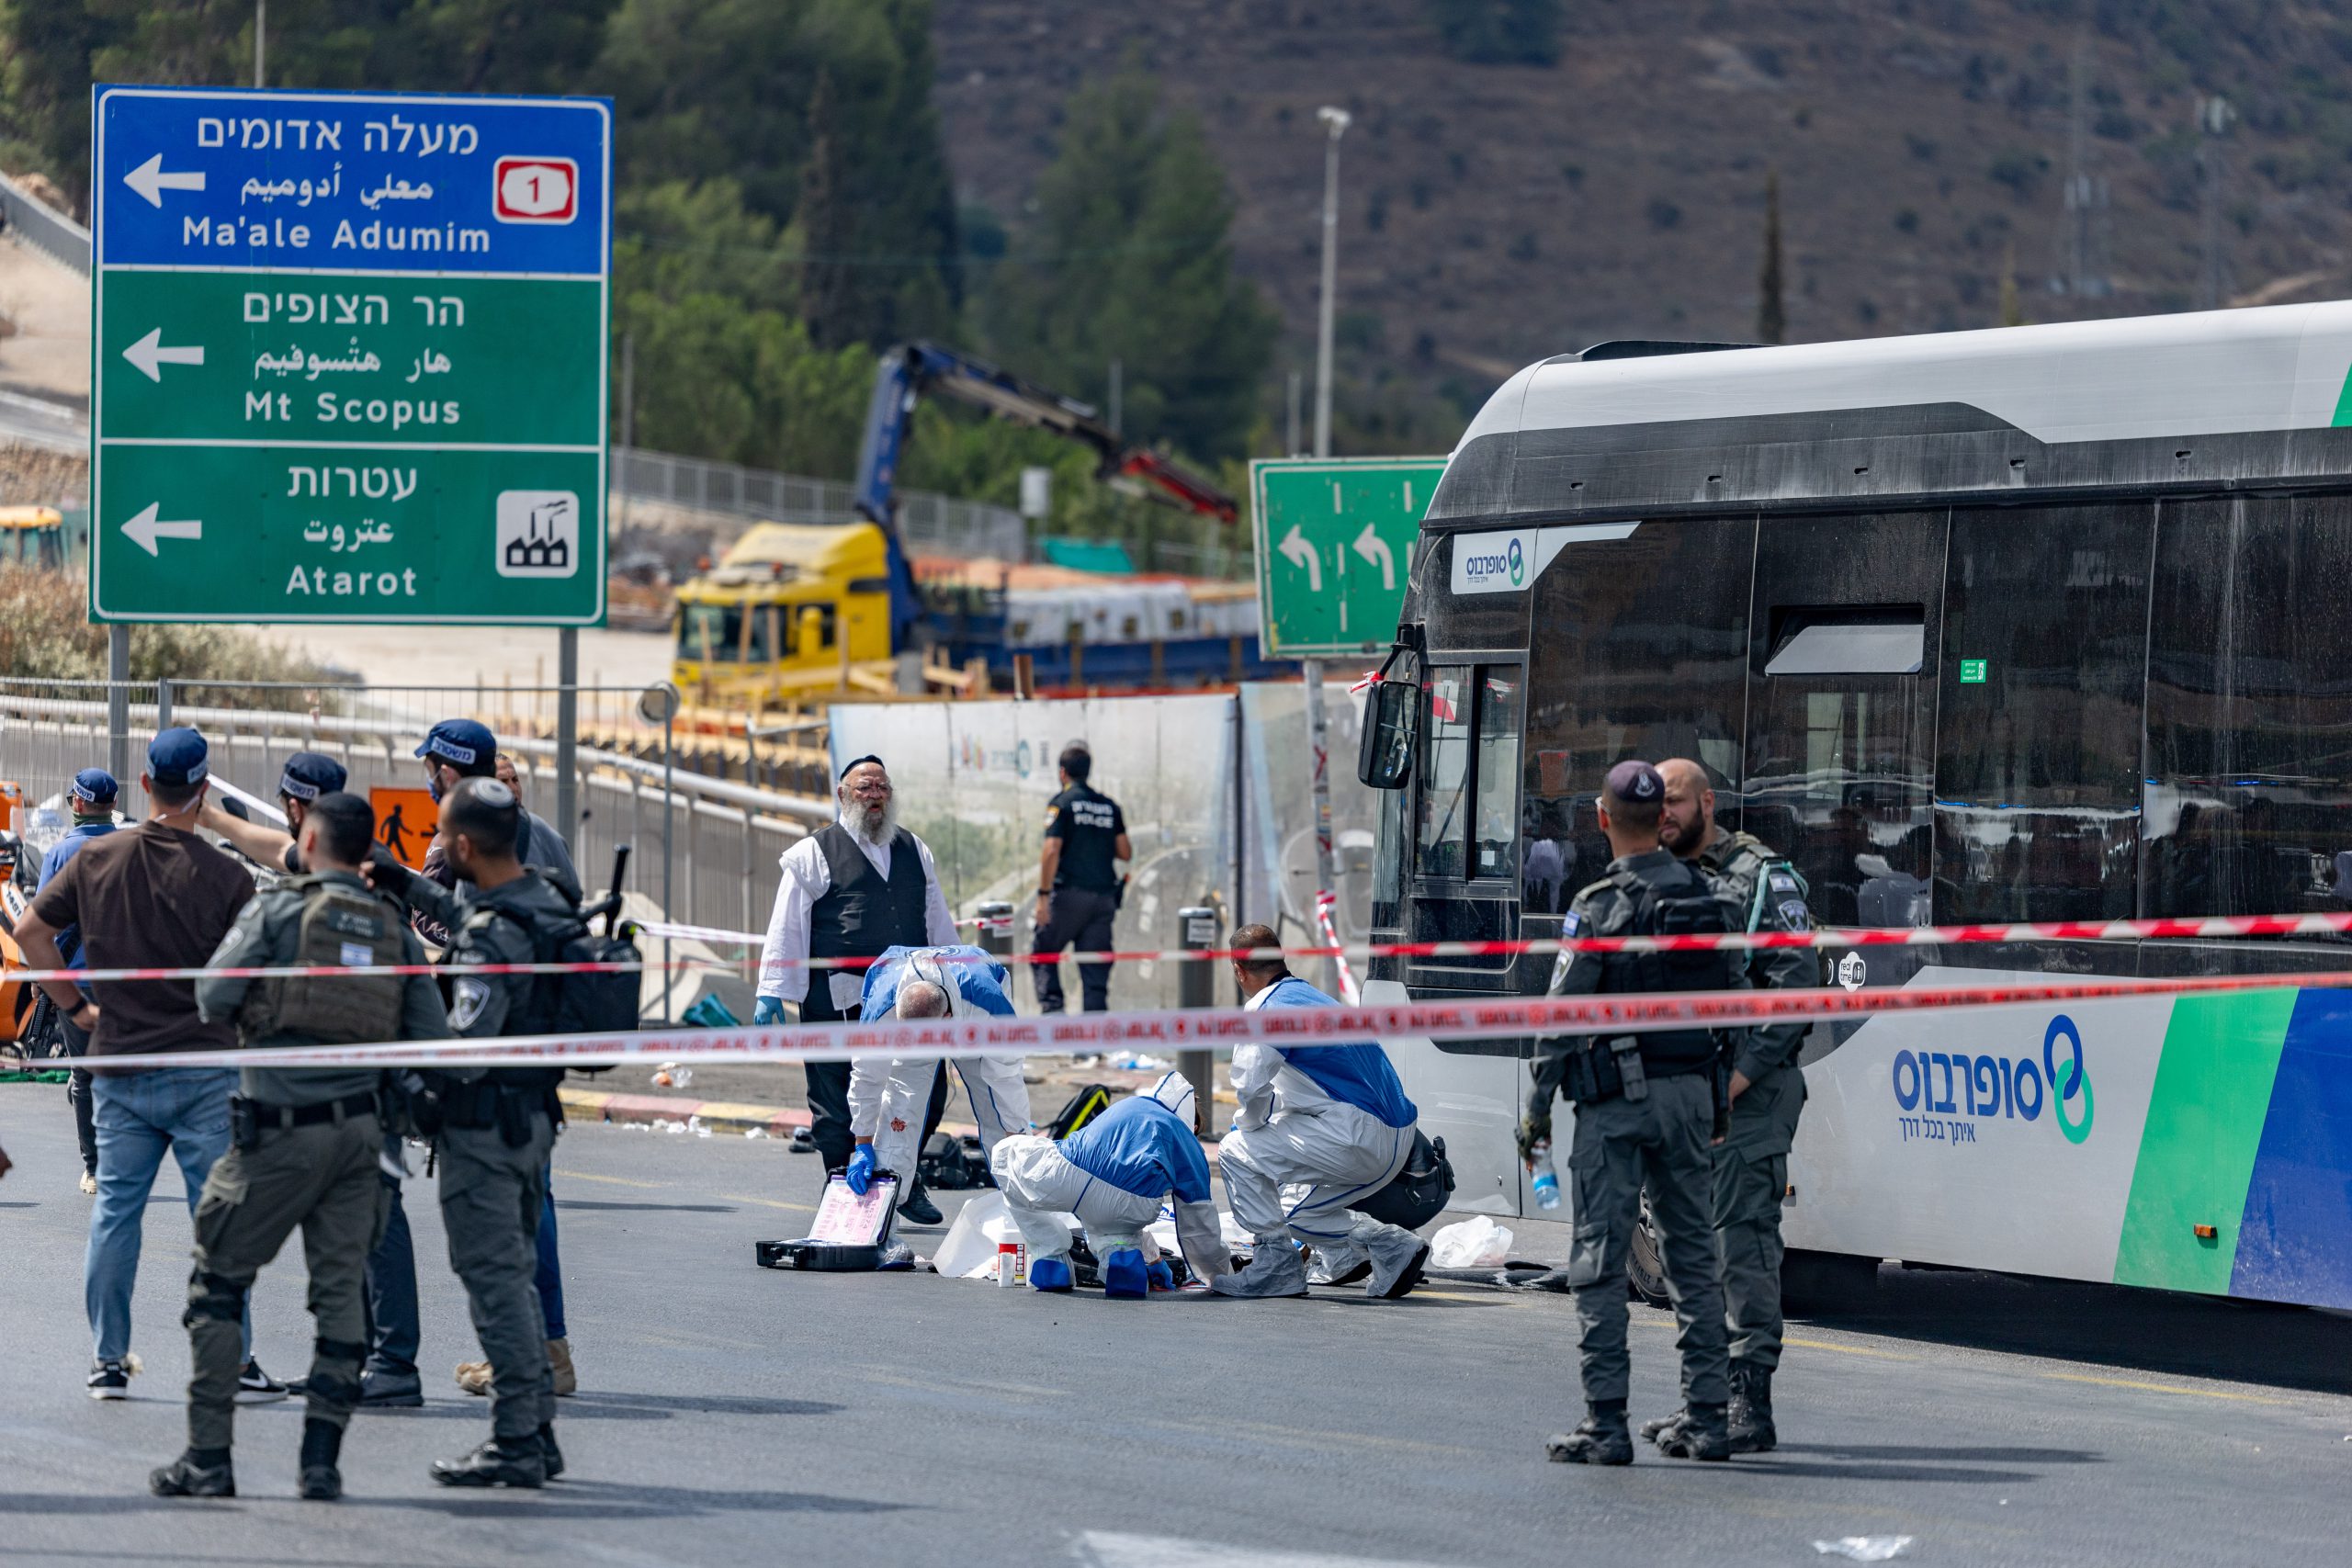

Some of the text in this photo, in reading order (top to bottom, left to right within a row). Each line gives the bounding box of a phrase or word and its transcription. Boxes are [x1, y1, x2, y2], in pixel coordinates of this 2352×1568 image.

[198, 115, 479, 158] מעלה אדומים
[359, 173, 434, 210] معلي
[527, 176, 539, 203] 1
[183, 217, 490, 253] Ma'ale Adumim
[243, 292, 465, 326] הר הצופים
[405, 347, 452, 383] هار
[245, 391, 460, 430] Mt Scopus
[288, 467, 417, 502] עטרות
[303, 519, 394, 552] عتروت
[286, 565, 417, 596] Atarot
[1466, 555, 1507, 576] סופרבוס
[1074, 812, 1114, 829] POLICE
[1841, 961, 1851, 971] real
[1841, 971, 1852, 982] time
[1893, 1049, 2044, 1122] סופרבוס
[1898, 1114, 1975, 1145] איתך בכל דרך
